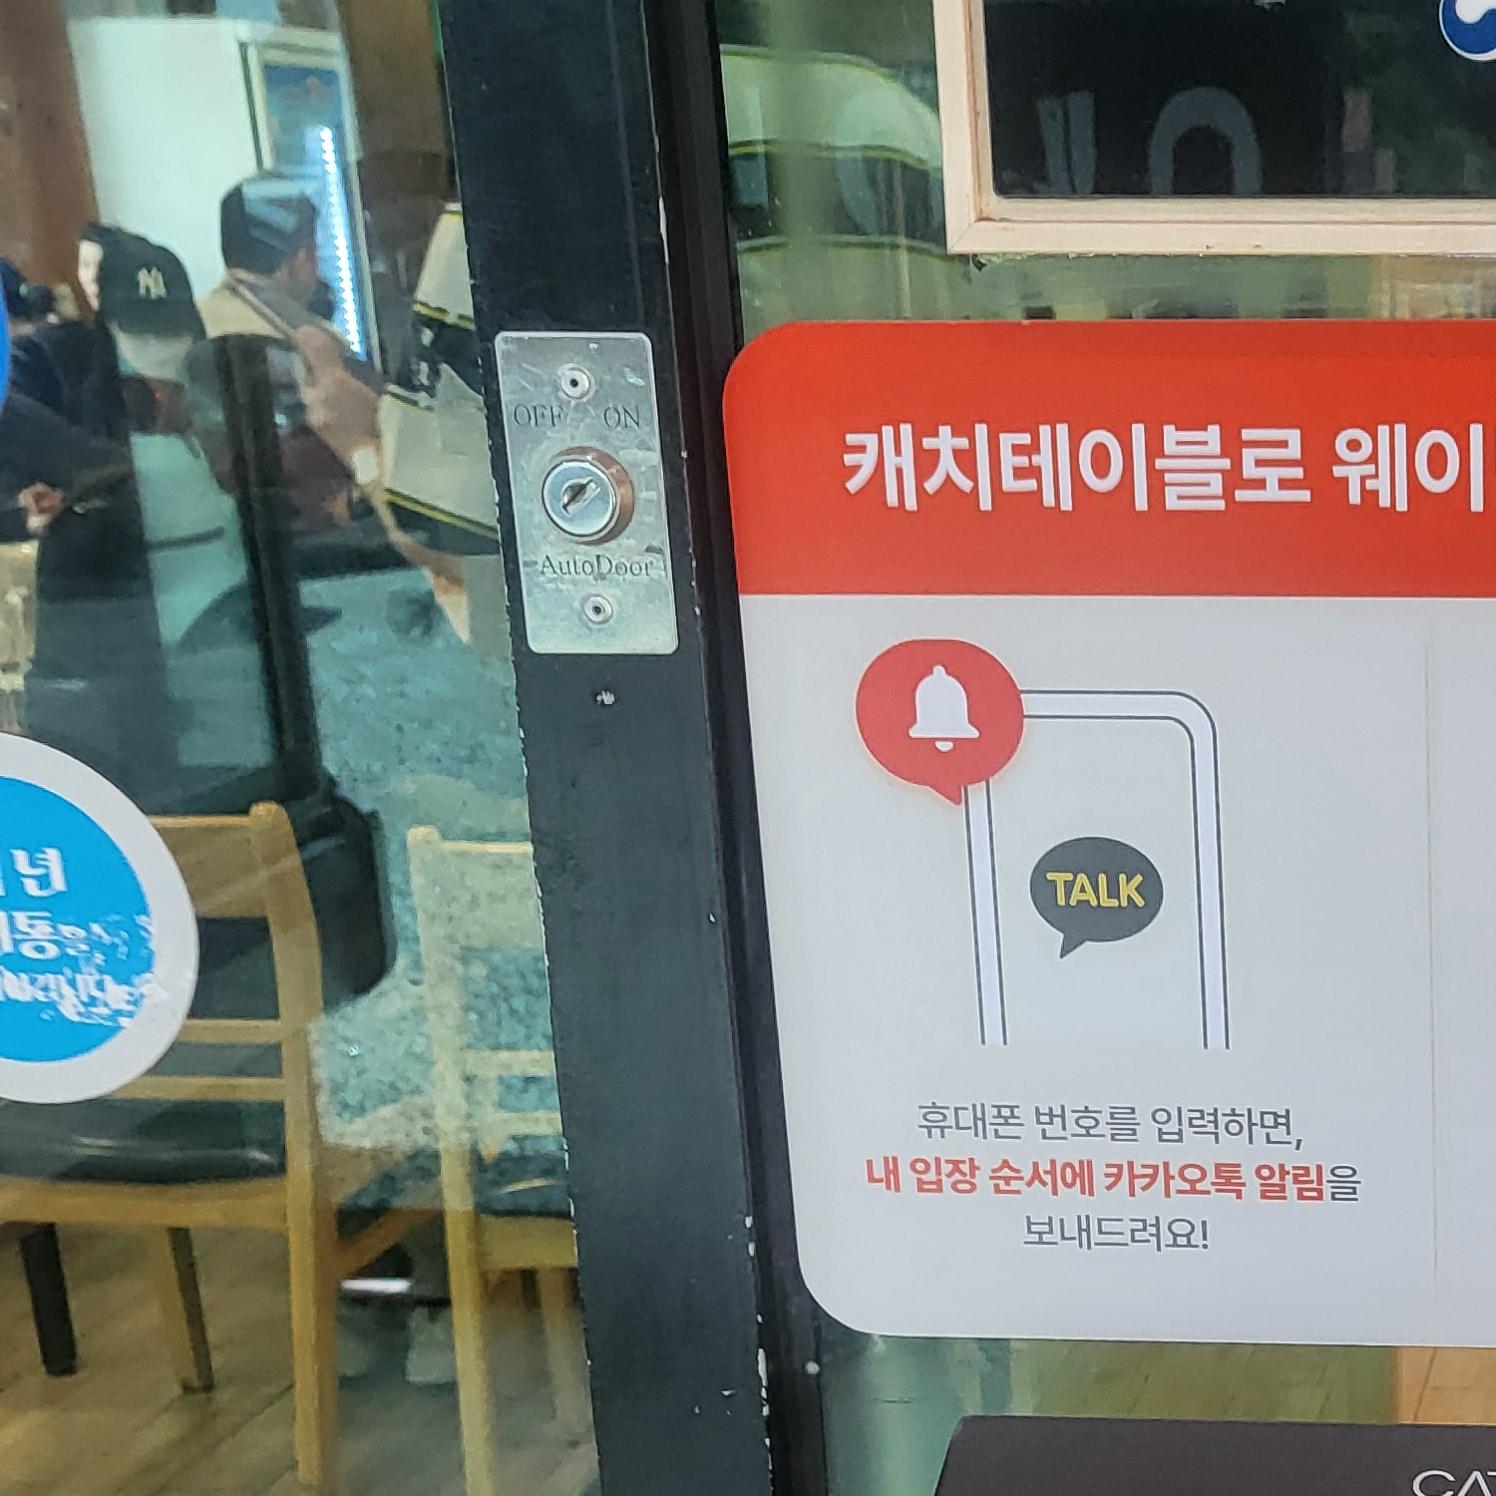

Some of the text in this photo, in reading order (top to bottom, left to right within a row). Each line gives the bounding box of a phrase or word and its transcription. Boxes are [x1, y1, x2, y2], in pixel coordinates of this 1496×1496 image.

[514, 404, 563, 428] OFF
[603, 406, 640, 428] ON
[843, 421, 1311, 512] 캐치테이블로
[540, 555, 653, 577] AutoDoor
[1046, 871, 1146, 908] TALK
[918, 1101, 1303, 1151] 휴대폰 번호를 입력하면,
[866, 1156, 1362, 1202] 내 입장 순서에 카카오톡 알림을
[1023, 1214, 1210, 1251] 보내드려요!
